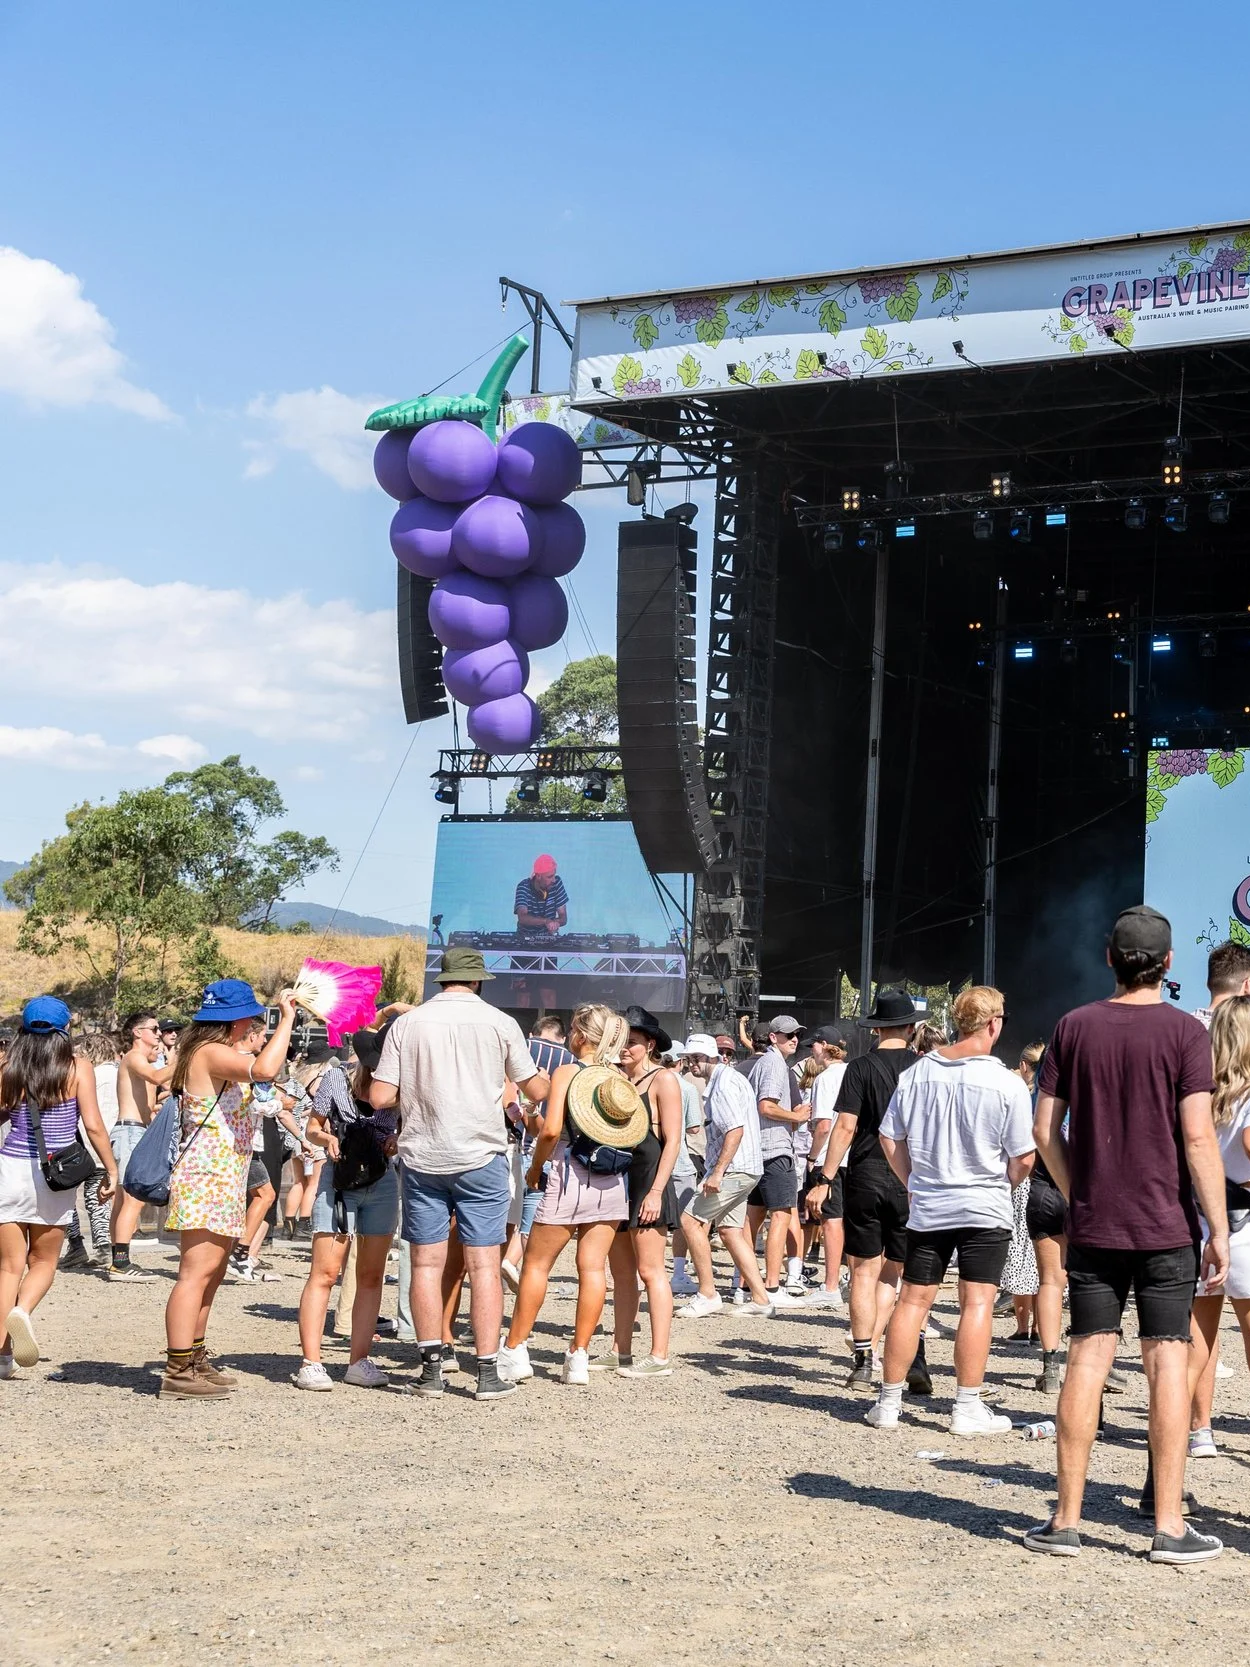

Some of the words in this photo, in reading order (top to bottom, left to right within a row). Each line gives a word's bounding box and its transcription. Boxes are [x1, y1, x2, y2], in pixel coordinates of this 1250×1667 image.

[1070, 274, 1095, 282] UNTITLED
[1096, 271, 1113, 279] GROUP
[1115, 268, 1142, 277] PRESENTS
[1062, 266, 1250, 319] GRAPEVINE
[1138, 312, 1177, 321] AUSTRALIA'S
[1203, 306, 1223, 314] MUSIC
[1225, 303, 1250, 312] PAIRING
